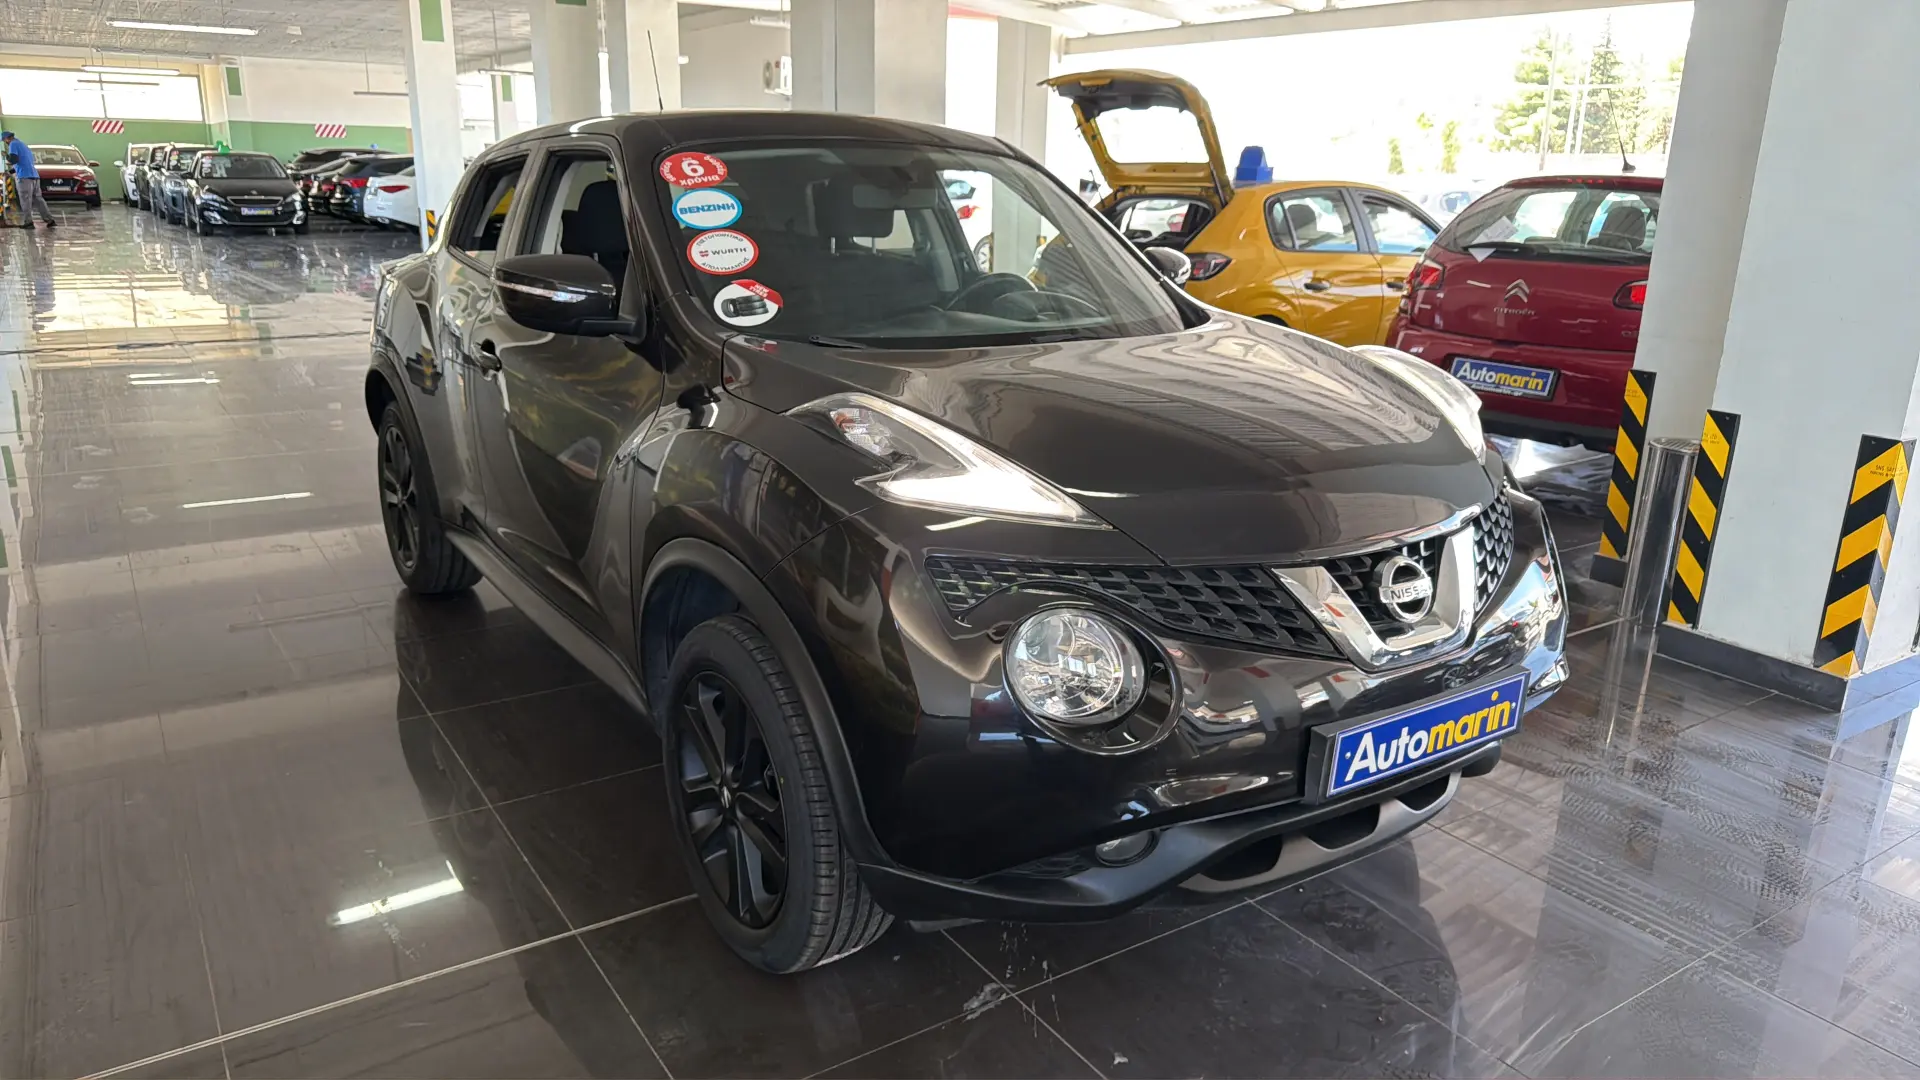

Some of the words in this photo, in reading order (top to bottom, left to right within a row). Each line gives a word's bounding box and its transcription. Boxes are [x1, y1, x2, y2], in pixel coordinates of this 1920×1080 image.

[681, 159, 705, 177] 6
[679, 174, 720, 187] χρόνια
[1456, 361, 1544, 391] Automarin
[1345, 690, 1511, 782] Automarin
